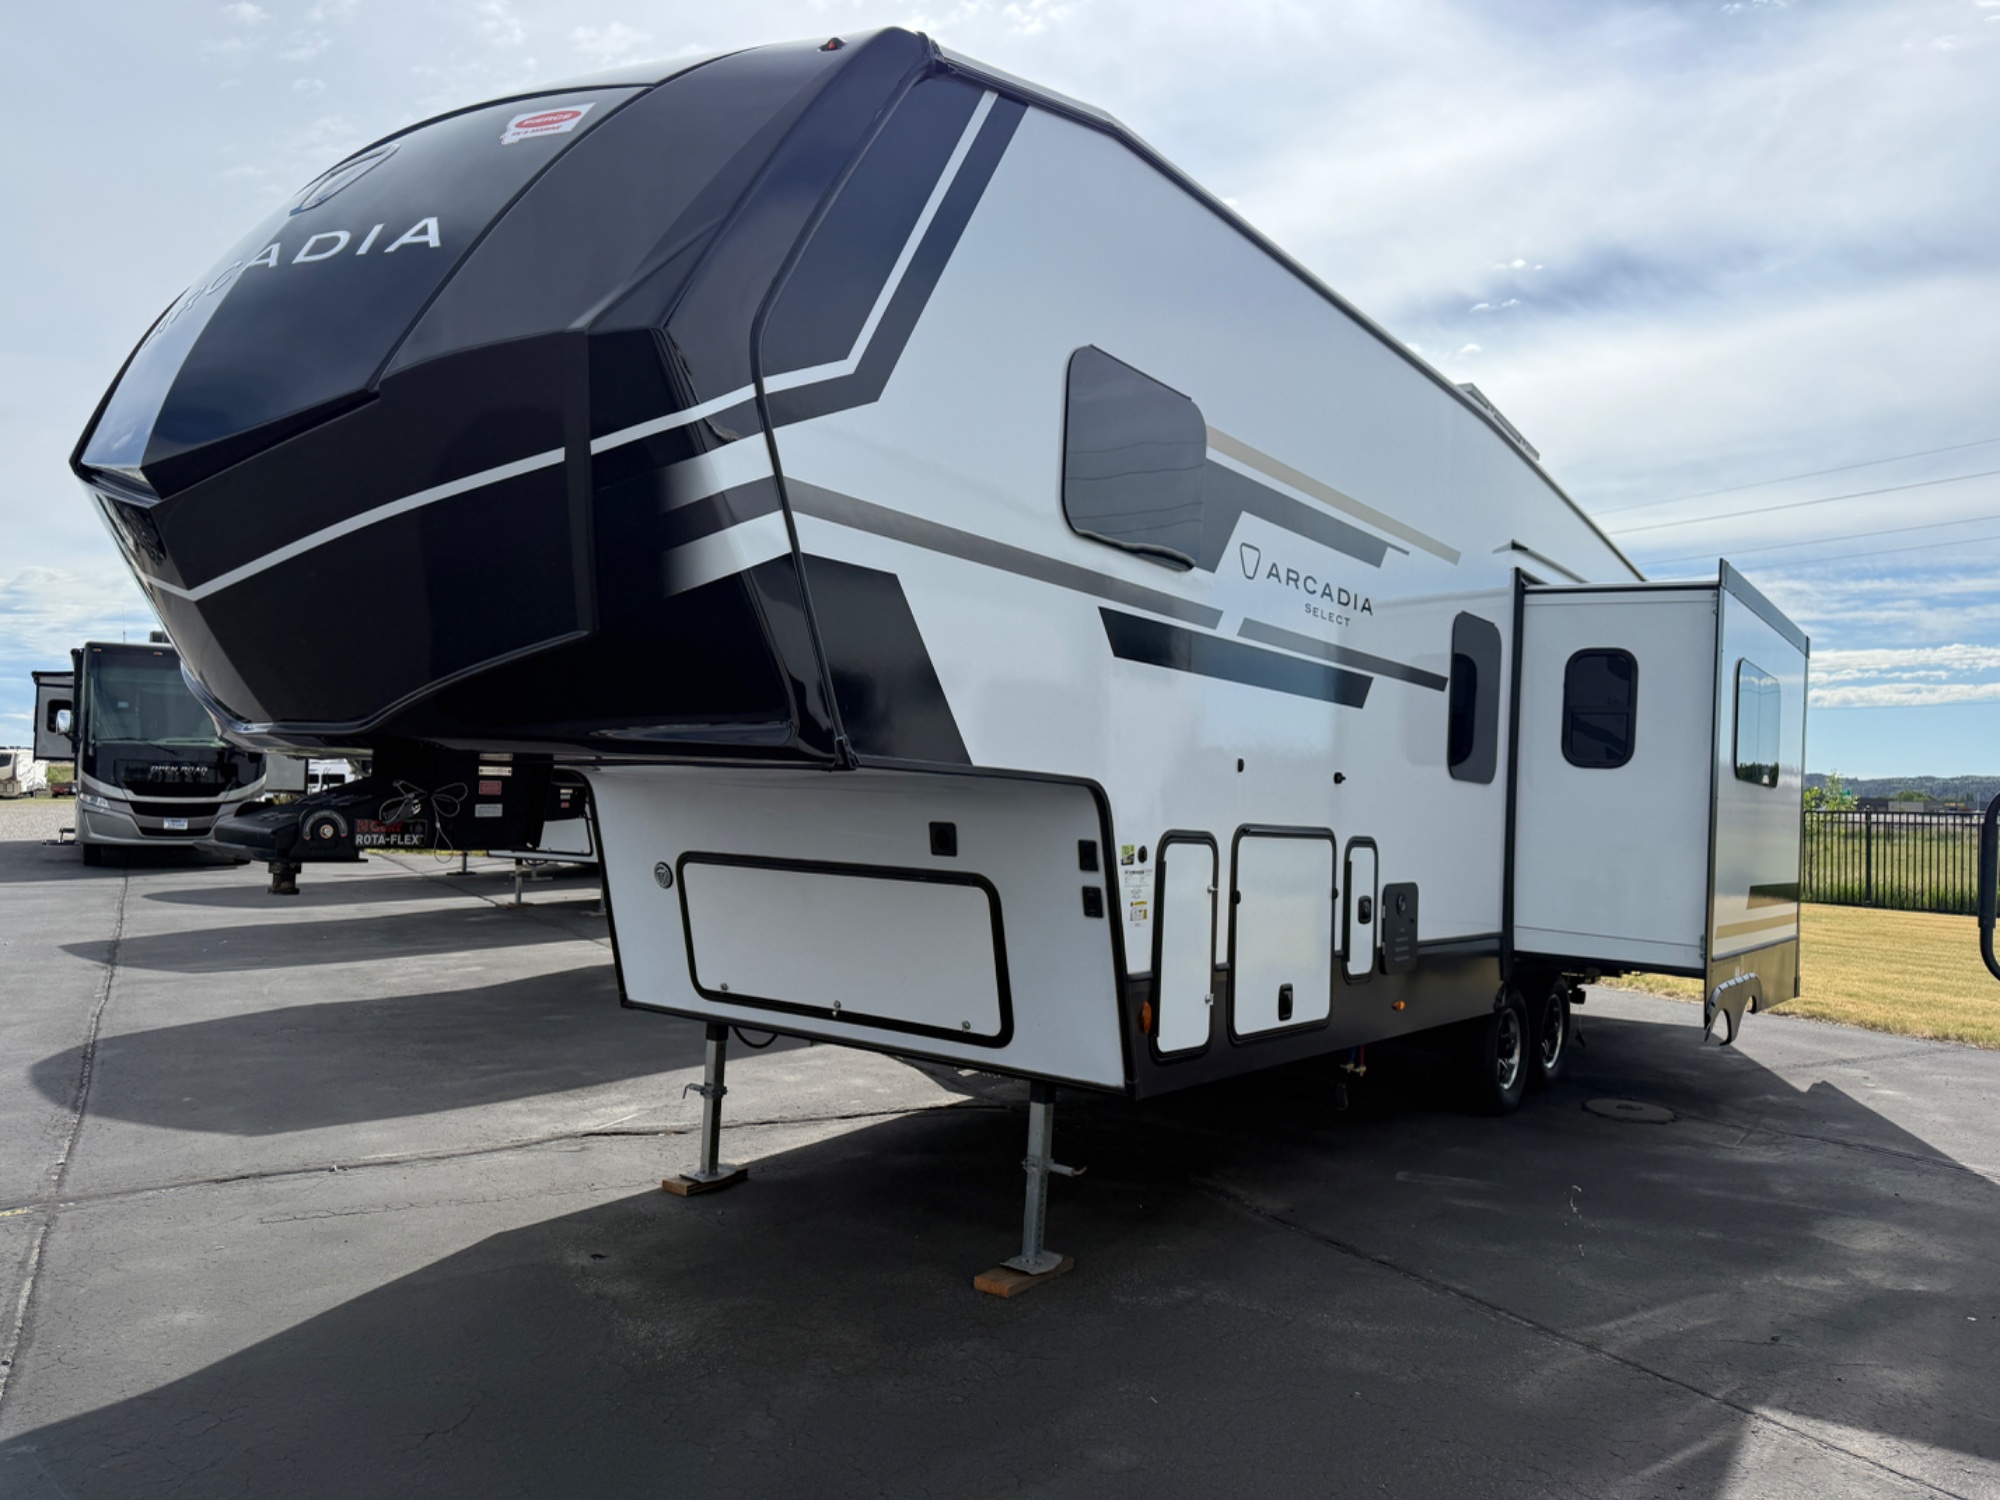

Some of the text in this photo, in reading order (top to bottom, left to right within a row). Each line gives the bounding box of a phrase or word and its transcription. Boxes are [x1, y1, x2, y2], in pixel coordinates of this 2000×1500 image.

[522, 113, 573, 125] PIERCE
[142, 216, 441, 350] ARCADIA
[1266, 562, 1374, 616] ARCADIA
[1304, 603, 1351, 627] SELECT
[355, 833, 420, 846] ROTA-FLEX
